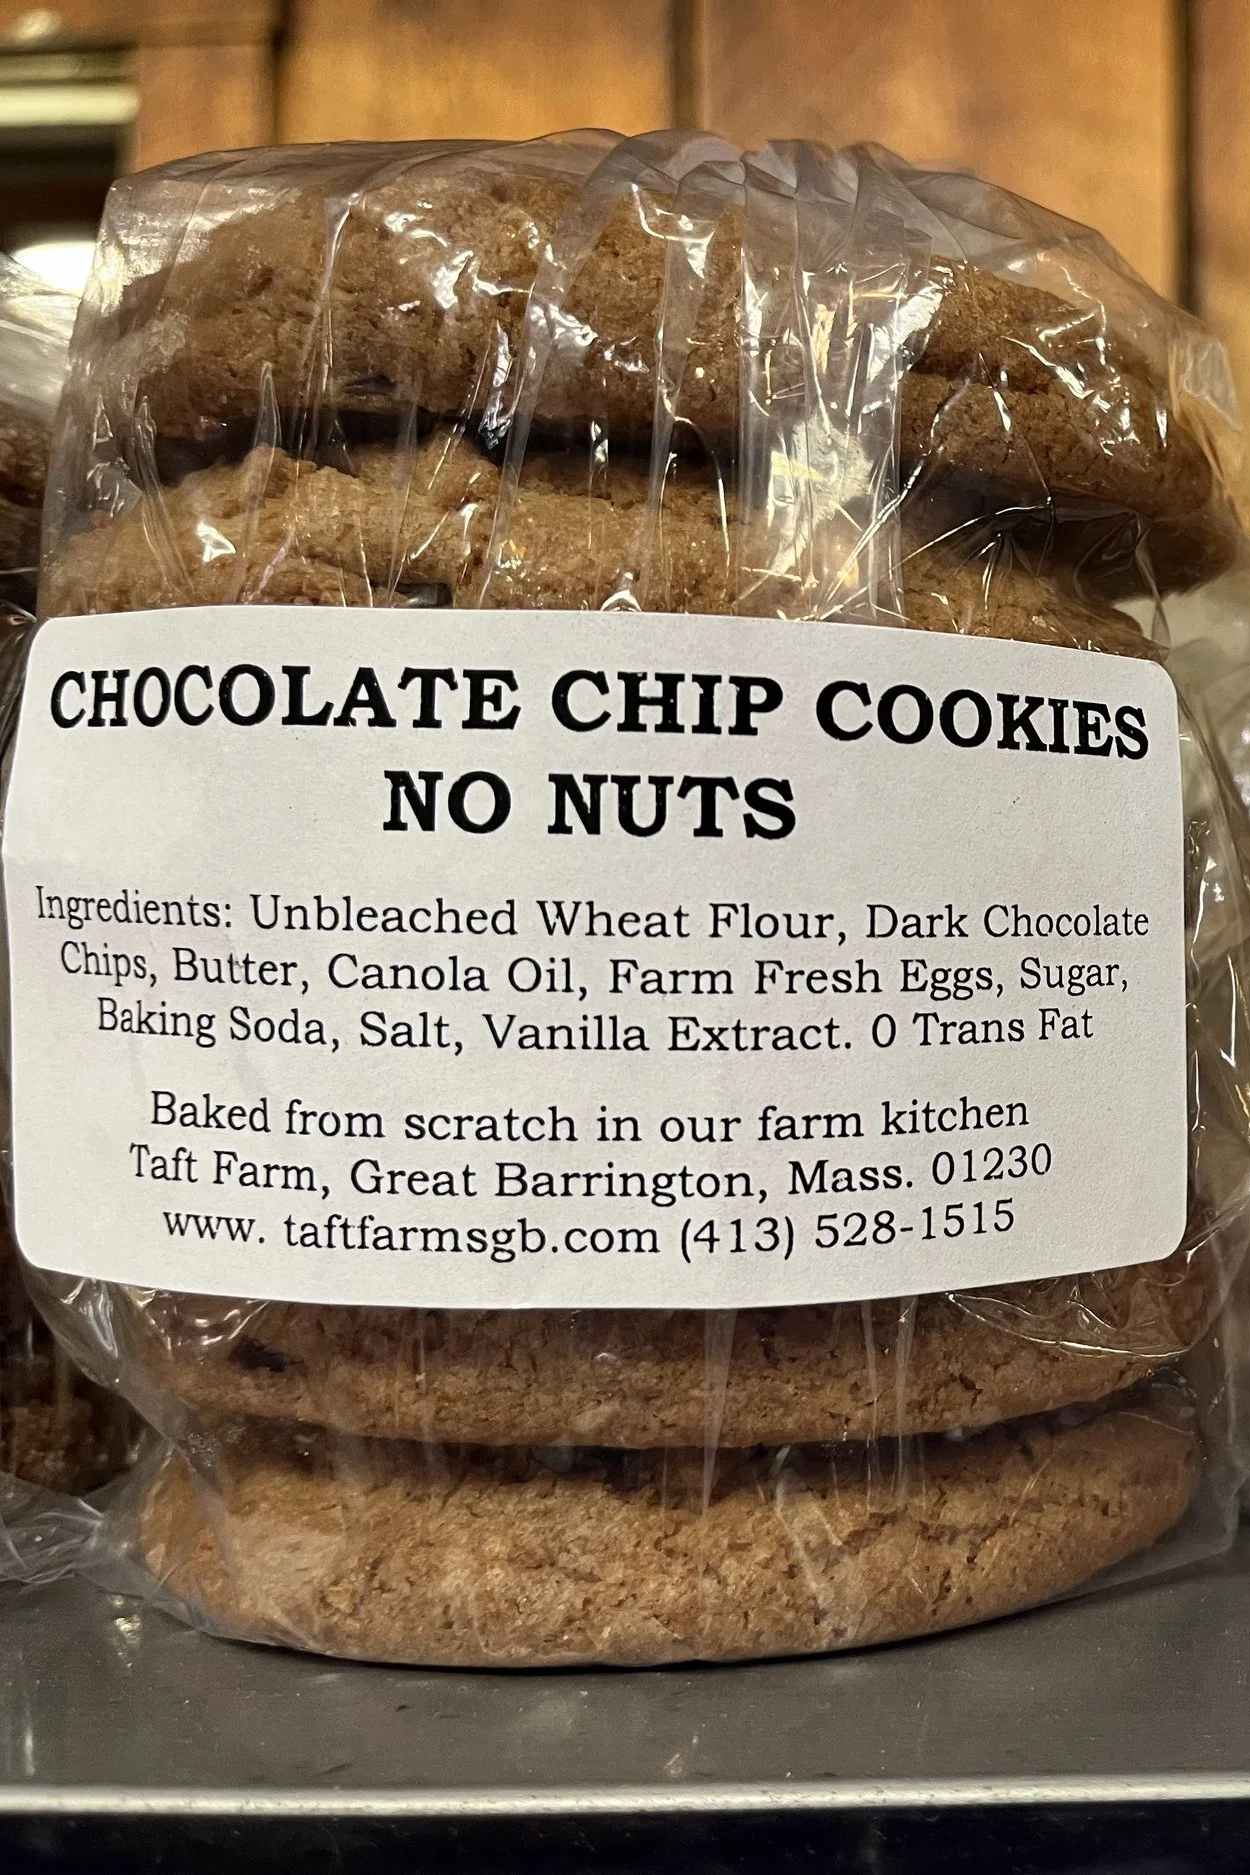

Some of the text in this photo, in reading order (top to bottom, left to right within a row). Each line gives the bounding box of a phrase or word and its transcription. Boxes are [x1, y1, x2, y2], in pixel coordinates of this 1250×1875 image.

[50, 663, 1149, 761] CHOCOLATE CHIP COOKIES
[382, 769, 797, 841] NO NUTS
[34, 885, 1150, 947] Ingredients: Unbleached Wheat Flour, Dark Chocolate
[60, 940, 1128, 1003] Chips, Butter, Canola Oil, Farm Fresh Eggs, Sugar,
[96, 996, 217, 1049] Baking
[229, 1005, 340, 1054] Soda,
[359, 1010, 463, 1057] Salt,
[481, 1013, 651, 1052] Vanilla
[667, 1015, 852, 1052] Extract.
[911, 1011, 1025, 1047] Trans
[1038, 1007, 1094, 1041] Fat
[150, 1090, 1030, 1144] Baked from scratch in our farm kitchen
[128, 1141, 1052, 1208] Taft Farm, Great Barrington, Mass. 01230
[162, 1196, 1015, 1264] www. taftfarmsgb.com (413) 528-1515
